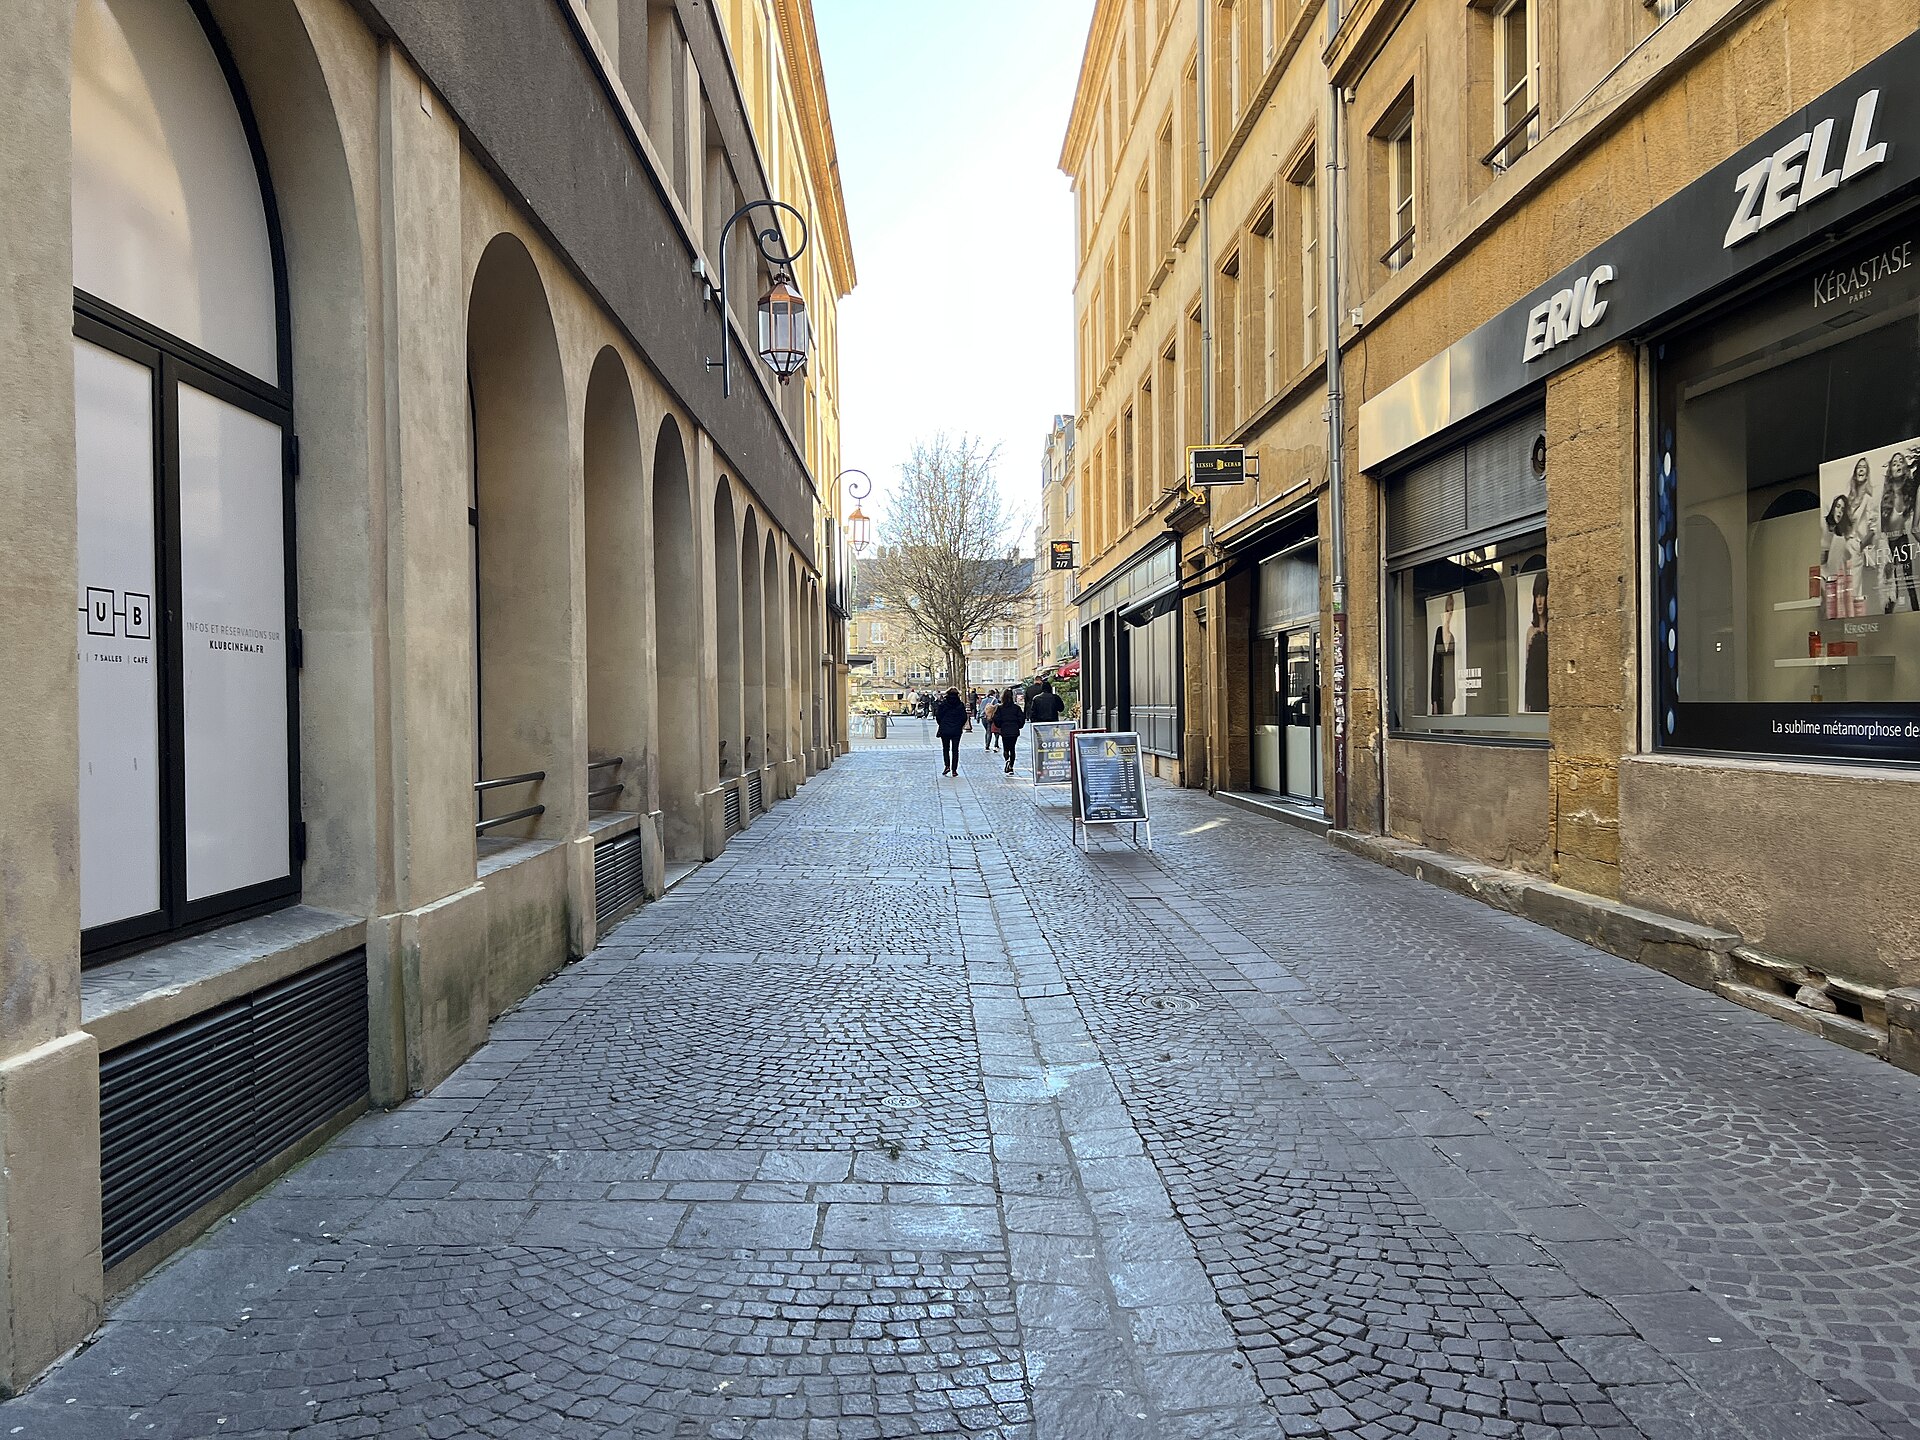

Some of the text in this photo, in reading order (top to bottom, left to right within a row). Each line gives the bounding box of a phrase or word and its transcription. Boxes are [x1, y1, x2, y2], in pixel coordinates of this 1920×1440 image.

[1522, 89, 1888, 363] ERIC ZELL
[1813, 241, 1912, 308] KÉRASTASE
[1848, 288, 1873, 304] PARIS
[1055, 560, 1068, 568] 7/7
[186, 622, 209, 633] INFOS
[210, 624, 219, 634] ET
[268, 631, 280, 641] SUR
[209, 640, 264, 654] KLUBCINEMA.FR
[100, 654, 122, 663] SALLES
[133, 656, 149, 664] CAFÉ
[1772, 719, 1920, 740] La sublime métamorphose de
